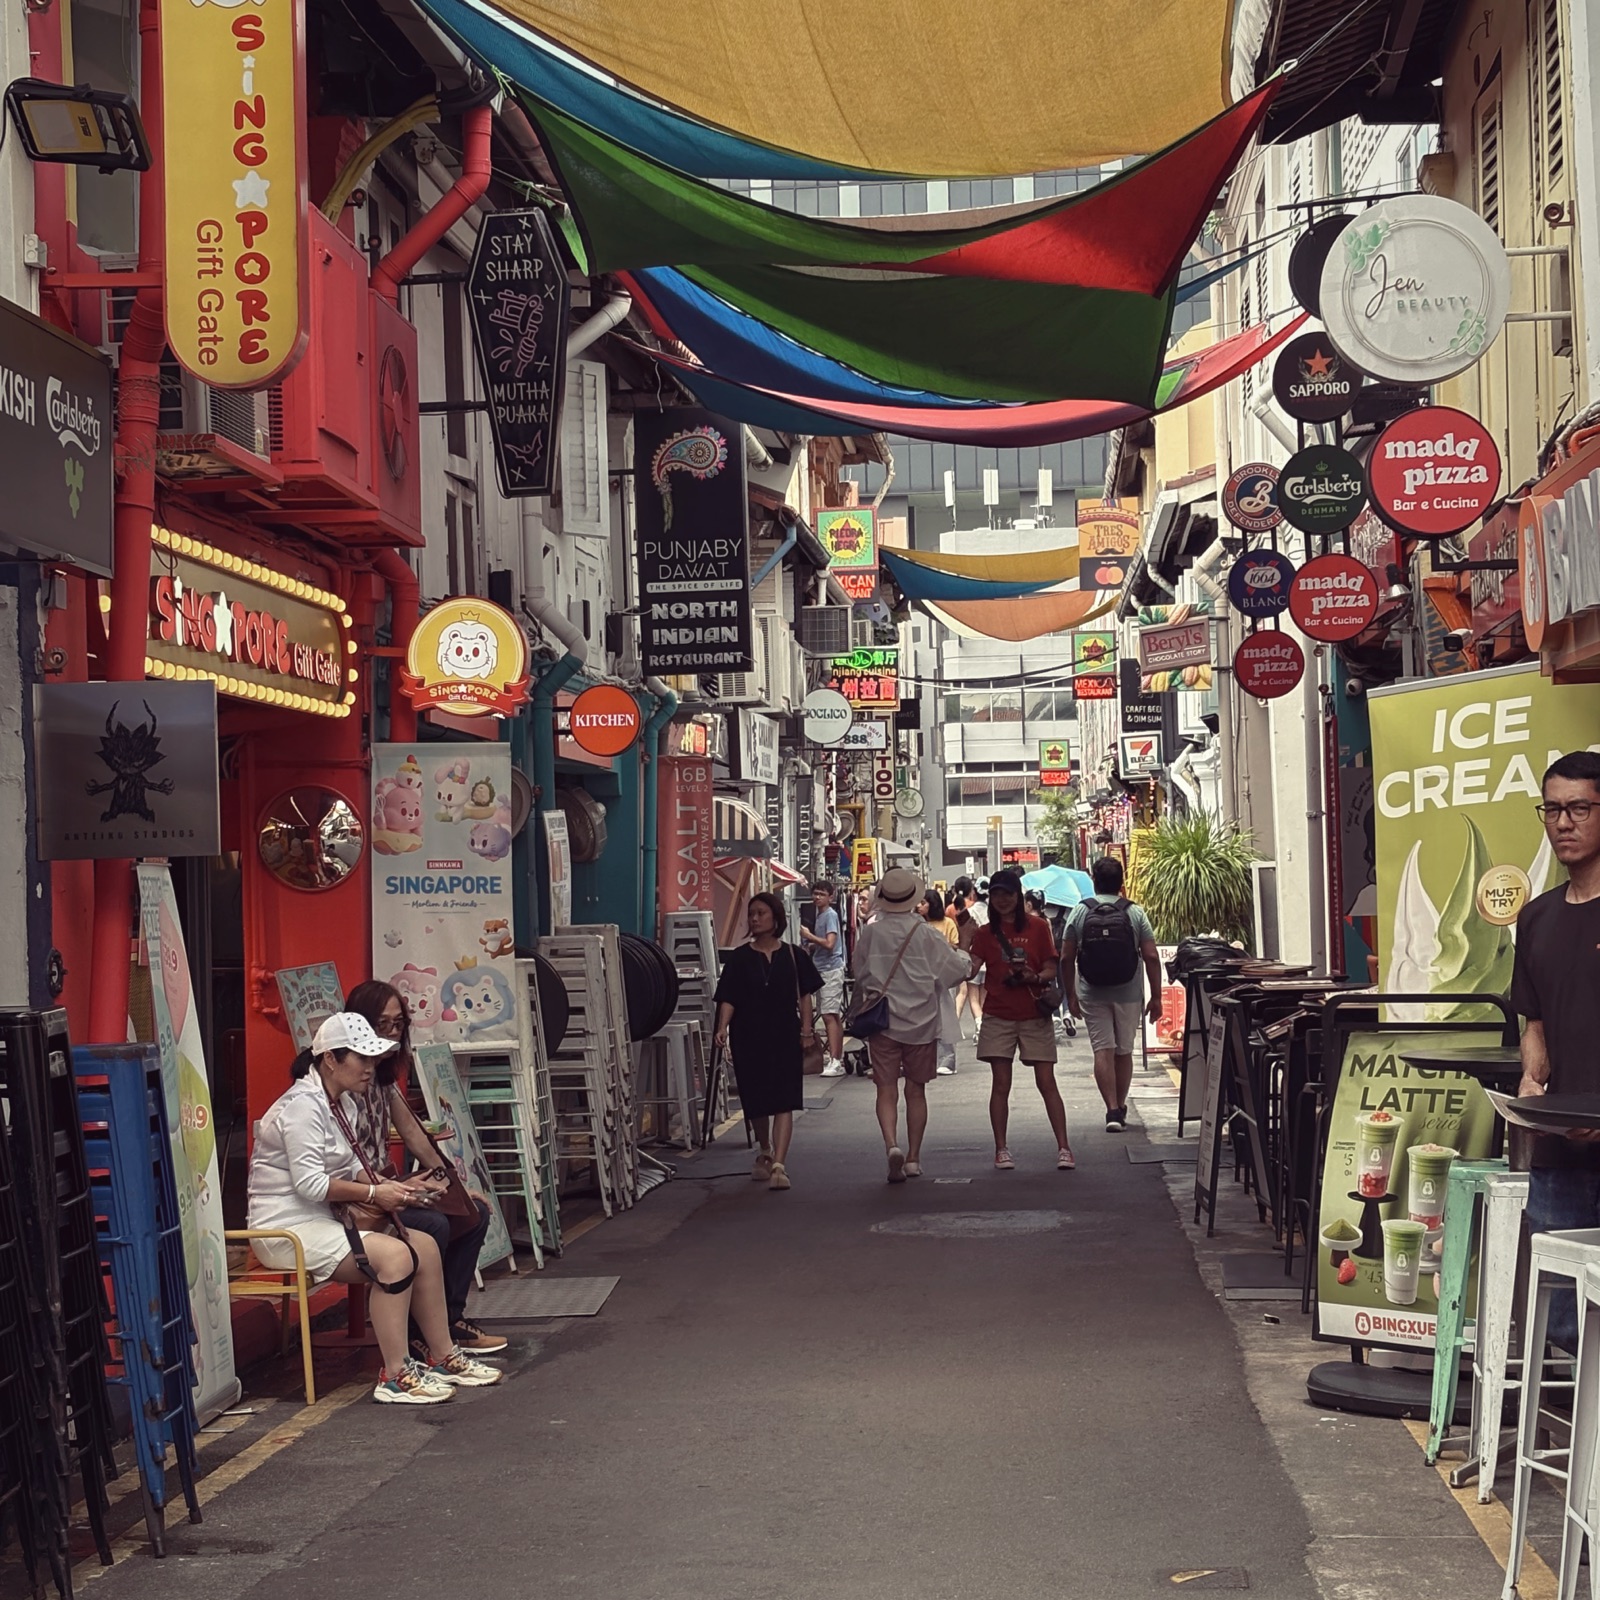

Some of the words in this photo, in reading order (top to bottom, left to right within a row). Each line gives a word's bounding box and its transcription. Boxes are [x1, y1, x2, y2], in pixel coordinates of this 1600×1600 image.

[196, 219, 224, 280] Gift
[490, 233, 533, 256] STAY
[485, 259, 543, 282] SHARP
[1365, 254, 1424, 319] Jen
[1397, 296, 1468, 309] BEAUTY
[196, 288, 225, 366] Gate
[493, 380, 550, 401] MUTHA
[1289, 381, 1350, 398] SAPPORO
[46, 376, 101, 452] Carlsberg
[496, 403, 549, 424] PUAKA
[1403, 461, 1489, 495] pizza
[1284, 475, 1361, 501] Carlsberg
[1301, 506, 1347, 515] DENMARK
[1393, 499, 1417, 511] Bar
[1421, 500, 1429, 510] e
[1433, 497, 1479, 509] Cucina
[1227, 501, 1274, 528] DEFENDER
[1094, 524, 1123, 538] TRES
[643, 538, 742, 563] PUNJABY
[1087, 535, 1130, 550] AMIGOS
[659, 562, 729, 580] DAWAT
[1249, 571, 1276, 585] 1664
[671, 583, 698, 591] SPICE
[720, 581, 741, 589] LIFE
[651, 601, 738, 620] NORTH
[1242, 596, 1287, 608] BLANC
[1311, 592, 1370, 615] pizza
[1304, 617, 1320, 626] Bar
[1331, 616, 1364, 625] Cucina
[652, 626, 738, 645] INDIAN
[1146, 628, 1203, 652] Beryl's
[649, 652, 743, 666] RESTAURANT
[1148, 651, 1185, 663] CHOCOLATE
[1186, 648, 1206, 657] STORY
[1253, 659, 1299, 678] pizza
[1248, 678, 1261, 686] Bar
[1269, 677, 1294, 685] Cucina
[1125, 705, 1147, 713] CRAFT
[575, 713, 635, 727] KITCHEN
[1134, 715, 1146, 723] DIM
[1432, 696, 1532, 753] ICE
[1130, 740, 1153, 755] 7
[674, 767, 707, 783] 16B
[676, 785, 702, 793] LEVEL
[703, 784, 709, 792] 2
[134, 829, 195, 839] STUDIOS
[676, 798, 699, 911] KSALT
[701, 807, 710, 892] RESORTWEAR
[385, 876, 502, 894] SINGAPORE
[1486, 887, 1521, 898] MUST
[450, 900, 478, 908] Friends
[1490, 898, 1516, 908] TRY
[1360, 1087, 1467, 1114] LATTE
[1418, 1112, 1465, 1131] series
[1372, 1316, 1437, 1336] BINGXUE
